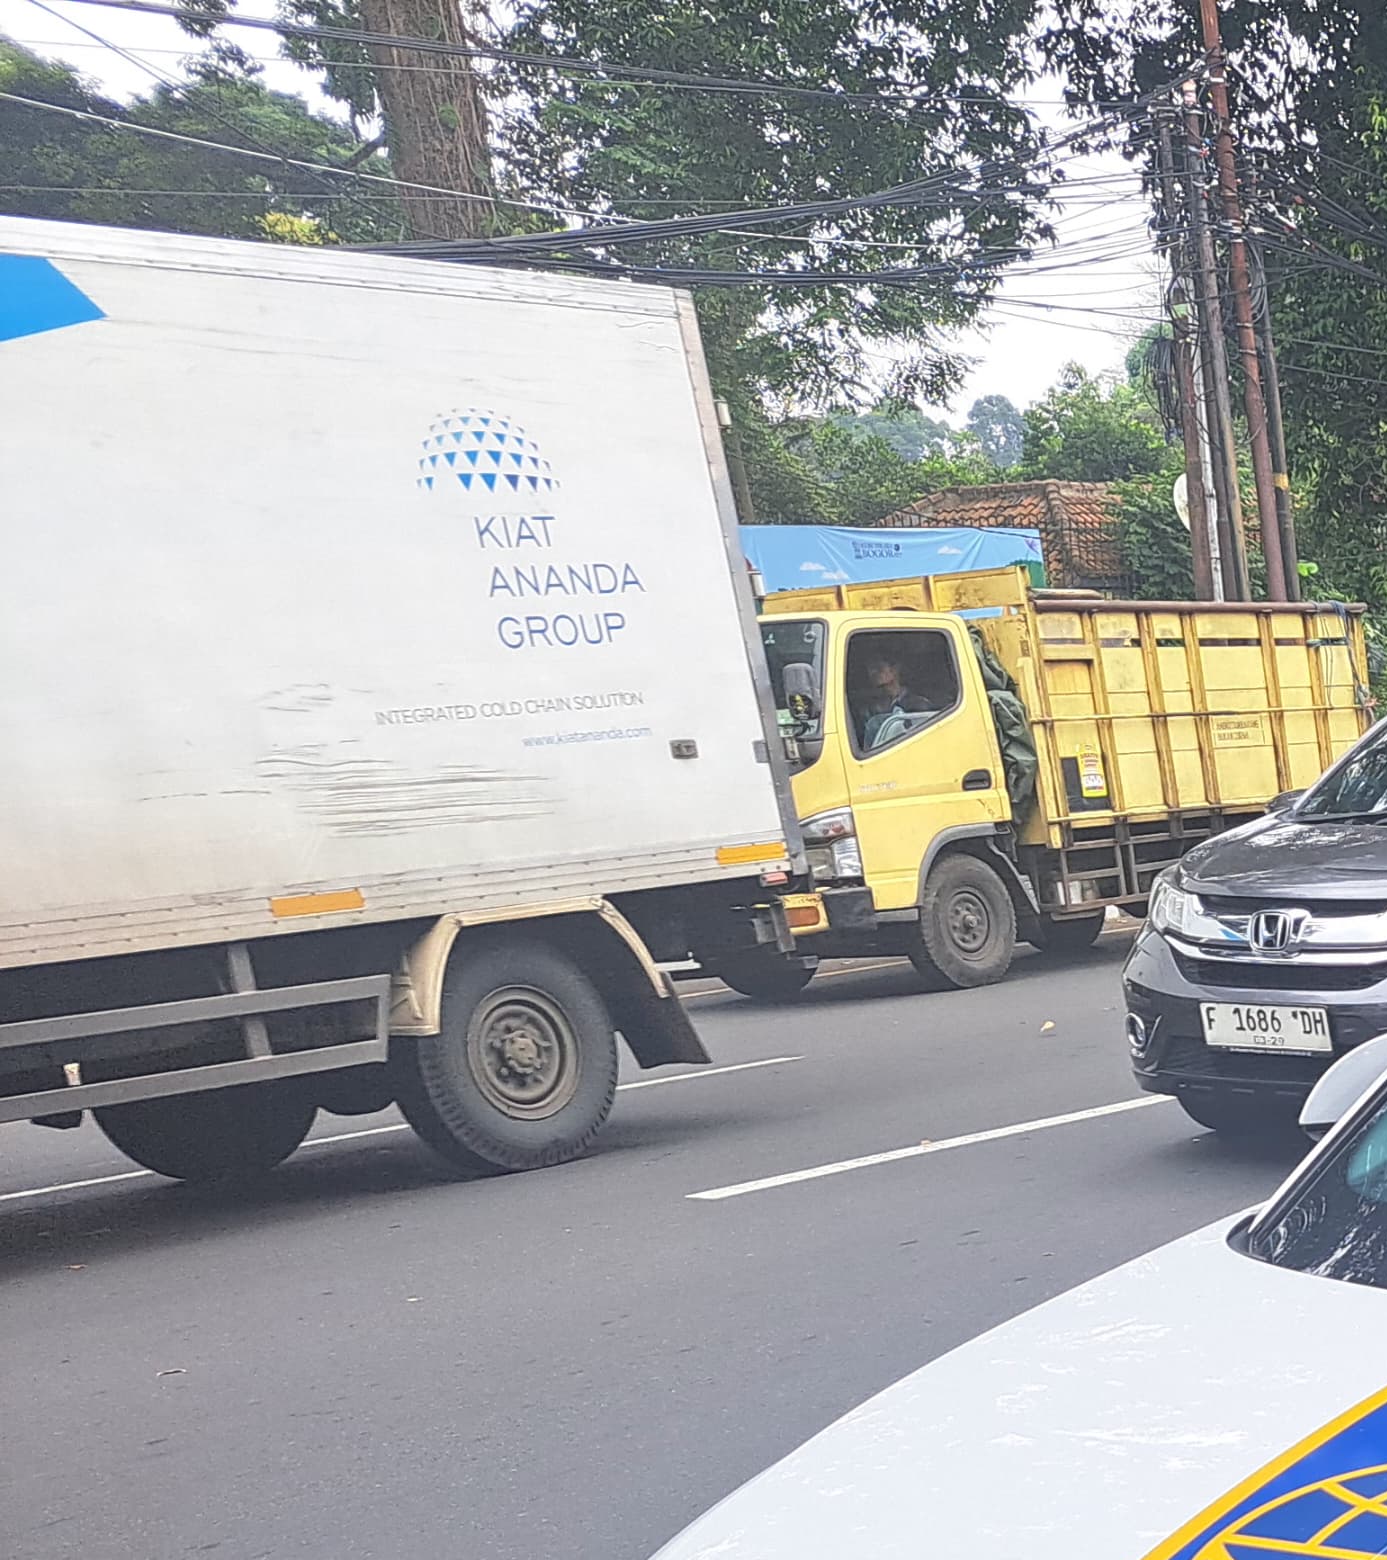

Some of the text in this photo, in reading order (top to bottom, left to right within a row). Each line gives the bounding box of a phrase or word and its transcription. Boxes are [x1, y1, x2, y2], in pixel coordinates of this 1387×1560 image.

[474, 516, 555, 548] KIAT
[489, 562, 646, 597] ANANDA
[497, 612, 625, 649] GROUP
[374, 691, 645, 725] INTEGRATED COLD CHAIN SOLUTION
[521, 727, 652, 747] www.kiatananda.com
[1206, 1006, 1326, 1036] F 1686 DH
